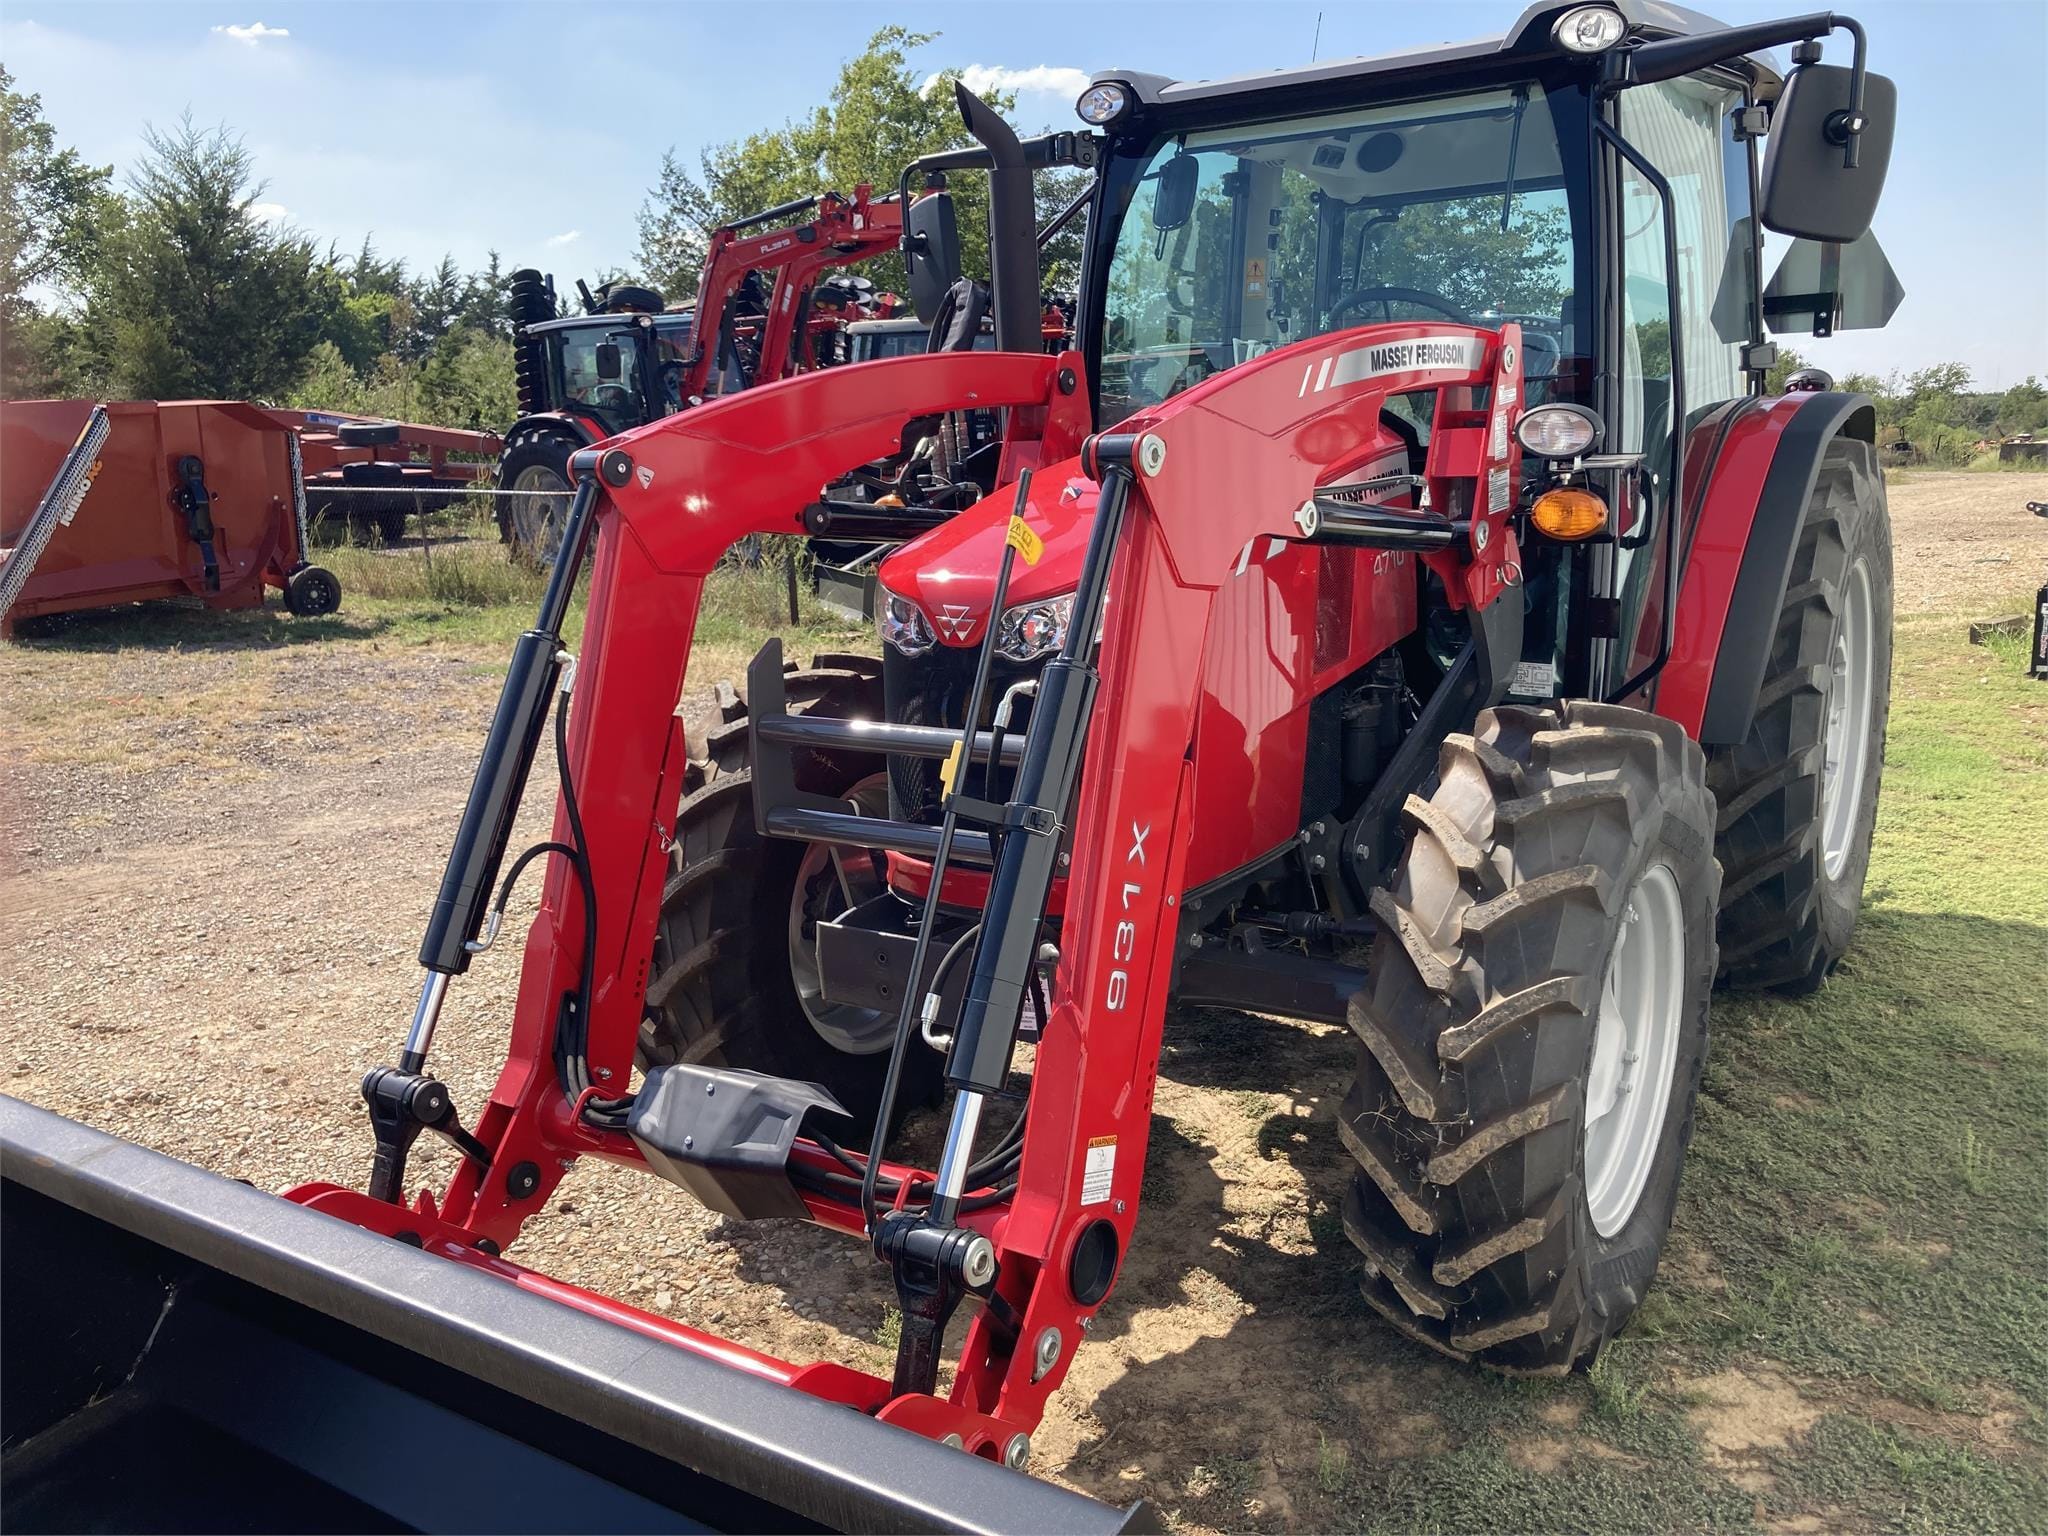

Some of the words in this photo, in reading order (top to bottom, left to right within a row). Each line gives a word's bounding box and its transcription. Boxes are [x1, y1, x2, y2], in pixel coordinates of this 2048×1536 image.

[1370, 344, 1413, 372] MASSEY
[1416, 343, 1464, 365] FERGUSON
[1373, 550, 1405, 576] 4710
[1106, 882, 1141, 1010] 931
[1128, 819, 1151, 866] X
[1094, 1135, 1118, 1147] WARNING
